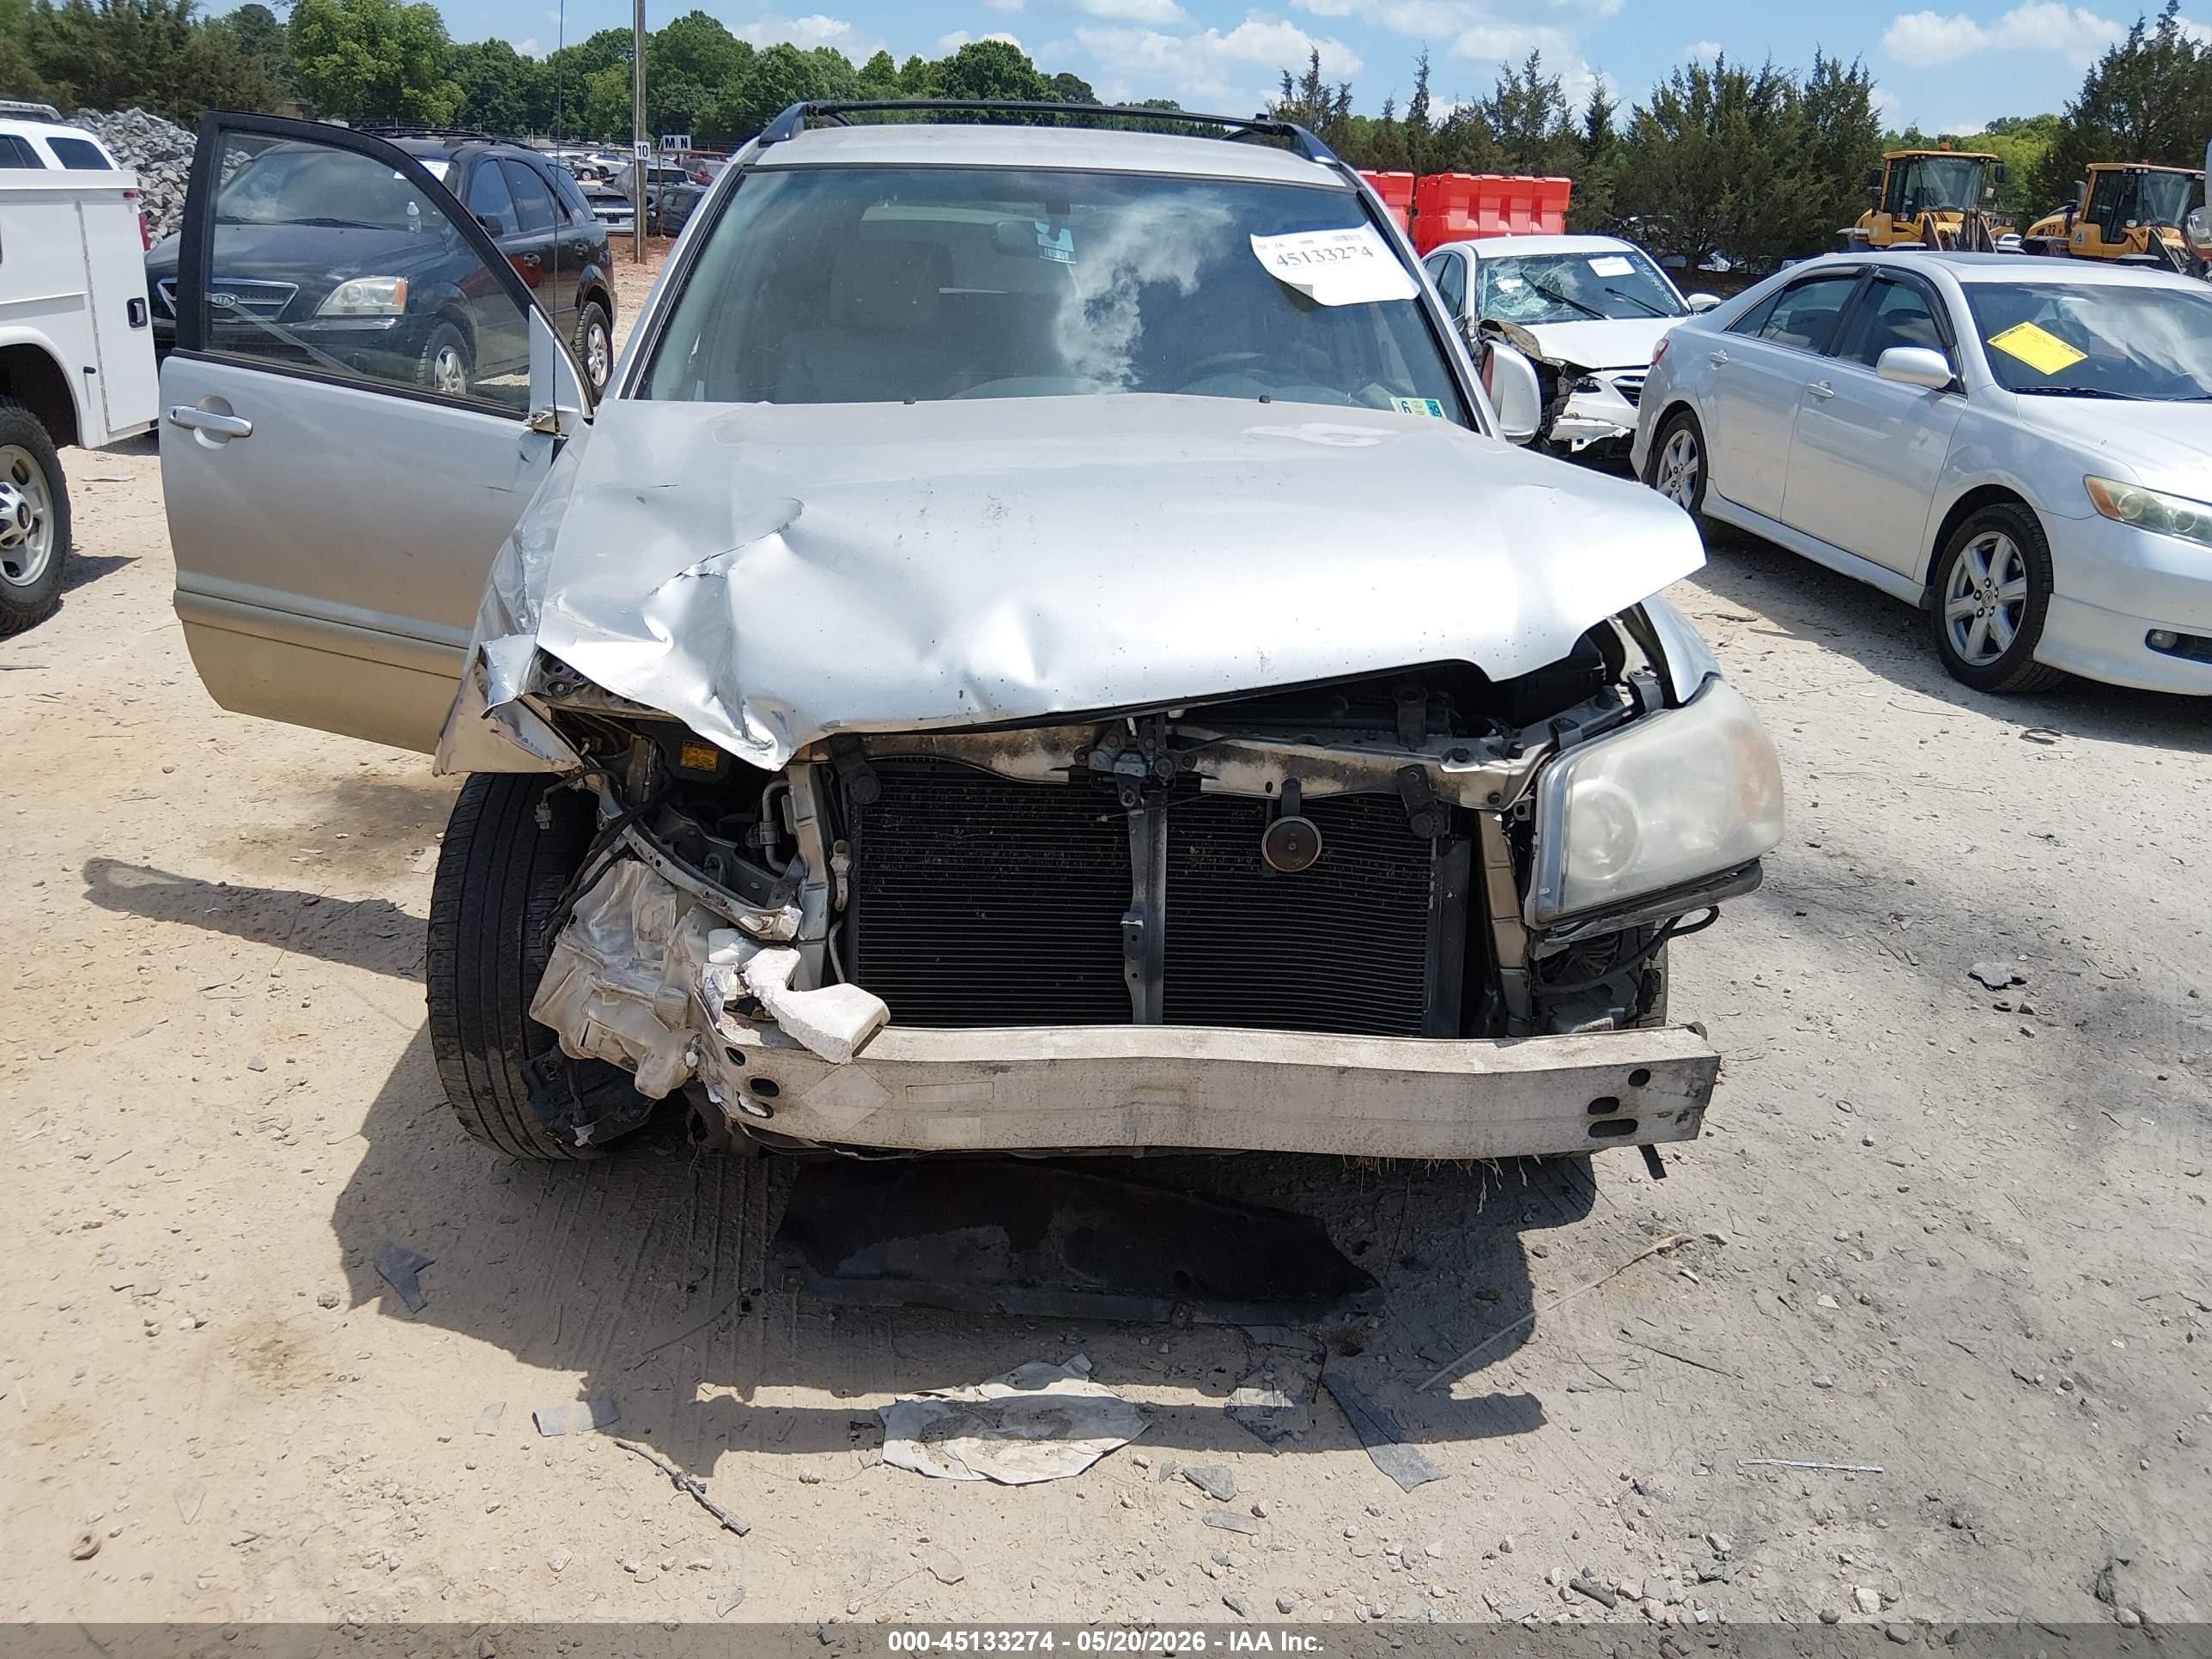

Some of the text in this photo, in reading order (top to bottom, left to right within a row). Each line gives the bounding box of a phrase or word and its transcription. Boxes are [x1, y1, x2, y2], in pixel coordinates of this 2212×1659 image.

[665, 137, 688, 149] M N
[637, 144, 648, 157] 10
[2045, 224, 2057, 237] 33
[1276, 246, 1374, 267] 45133274
